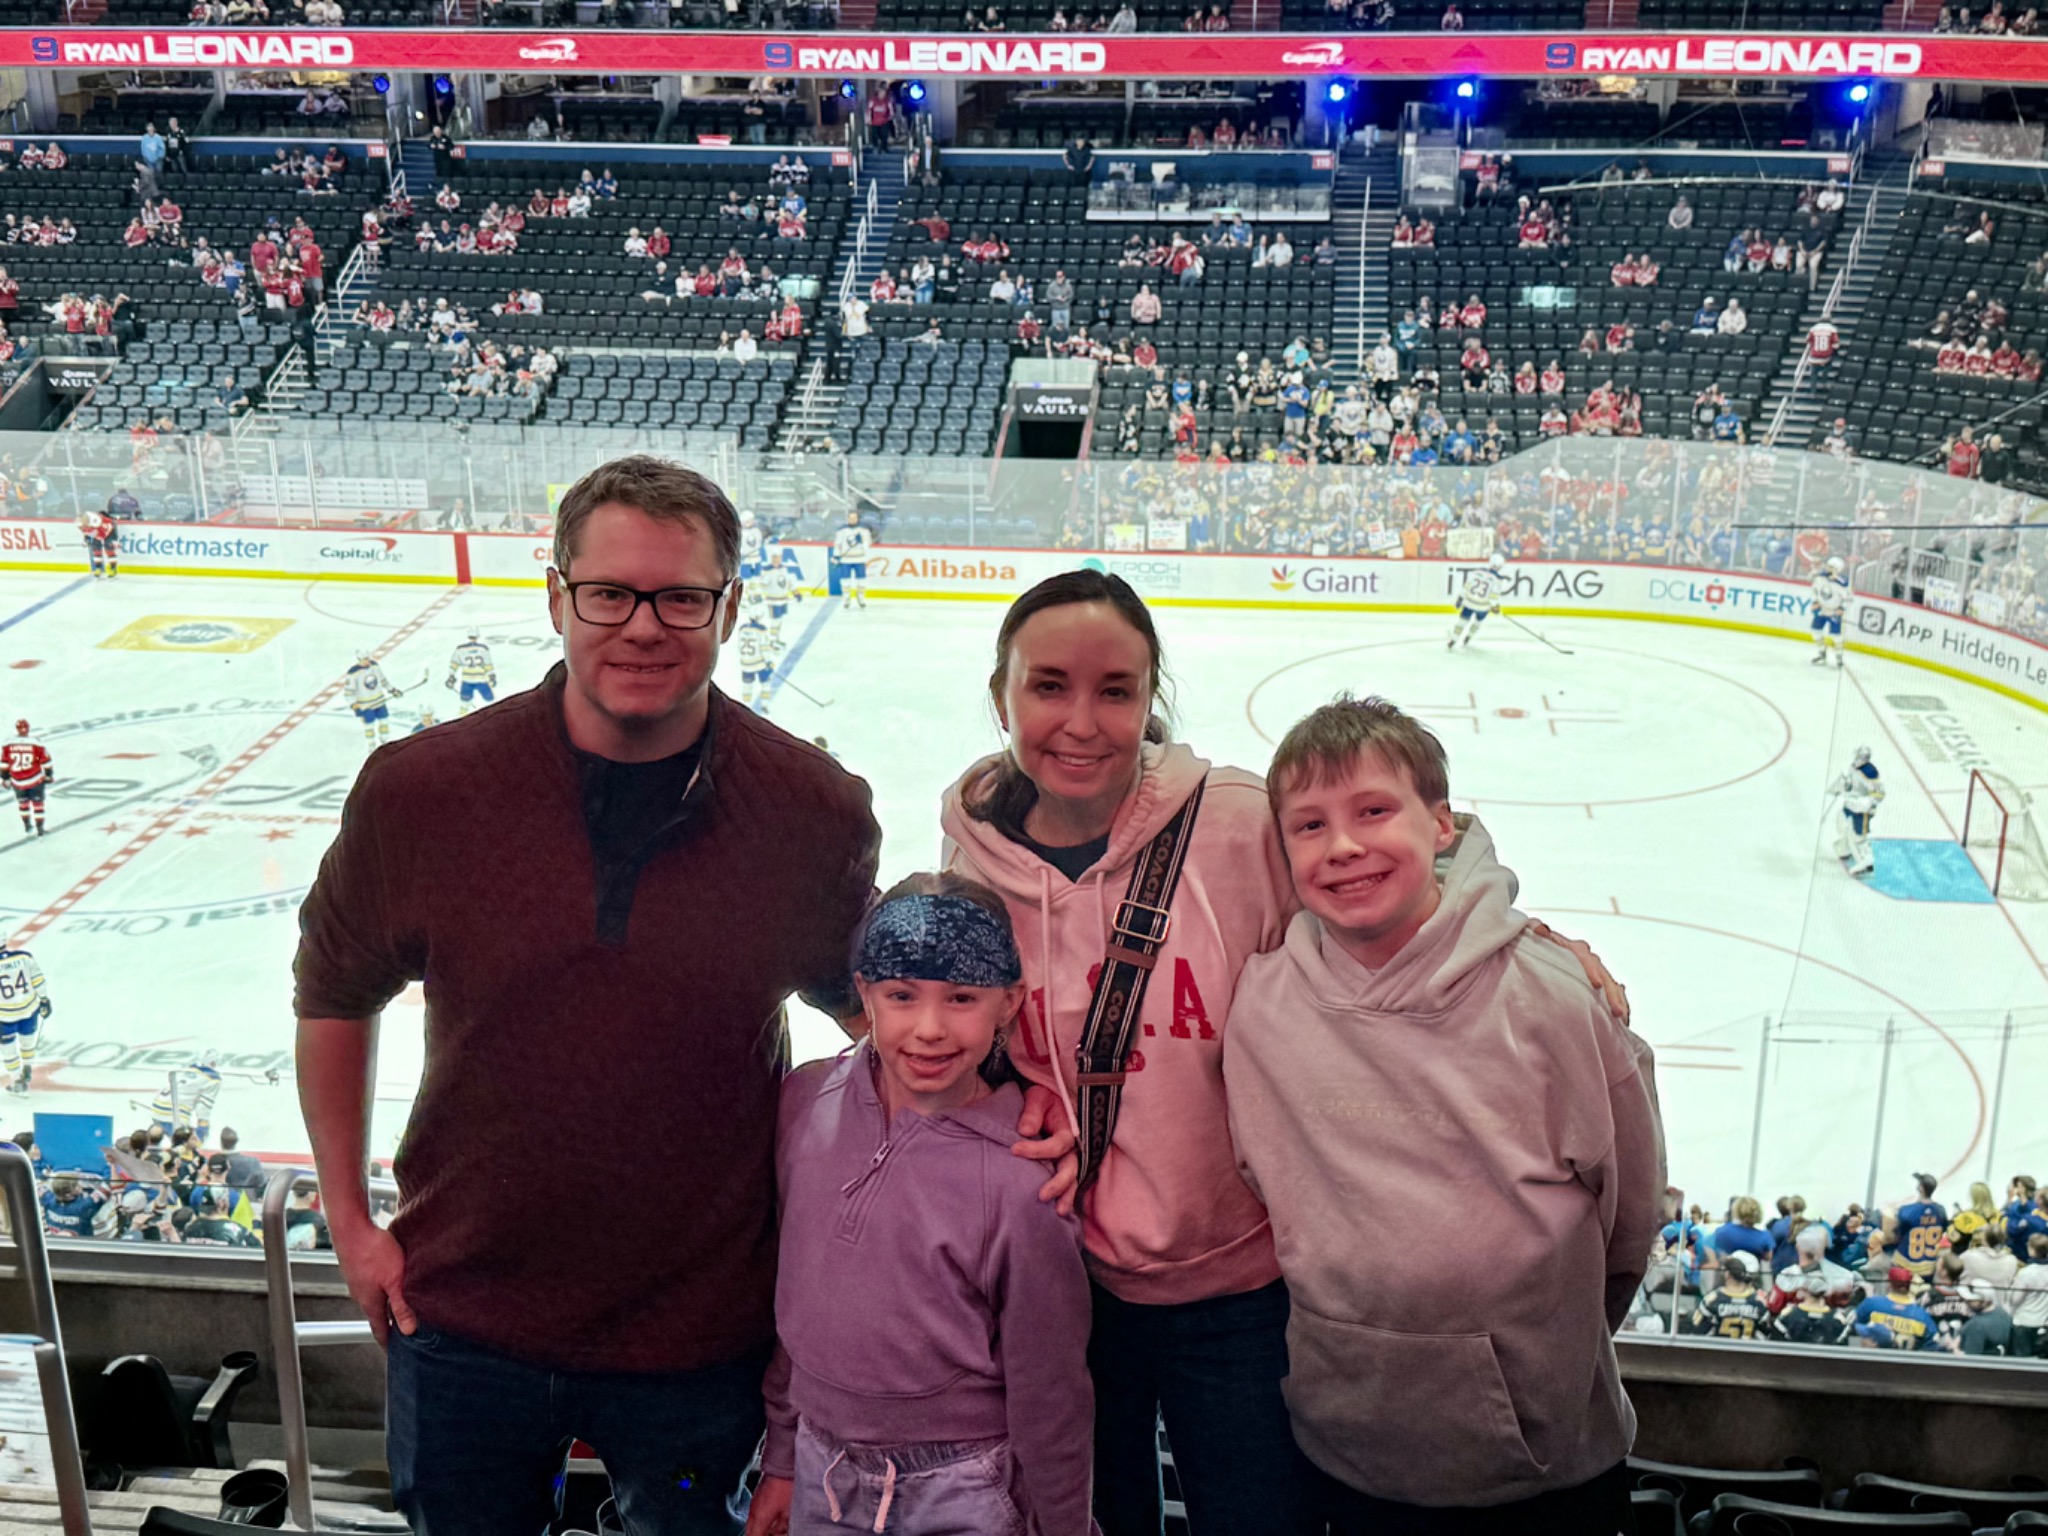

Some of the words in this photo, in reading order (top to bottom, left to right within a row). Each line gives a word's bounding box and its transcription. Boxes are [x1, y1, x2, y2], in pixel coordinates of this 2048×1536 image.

[32, 37, 59, 61] 9
[65, 43, 140, 62] RYAN
[144, 36, 353, 64] LEONARD
[764, 43, 793, 68] 9
[799, 48, 879, 69] RYAN
[884, 41, 1105, 72] LEONARD
[1545, 43, 1575, 69] 9
[1582, 47, 1670, 70] RYAN
[1675, 40, 1922, 73] LEONARD
[120, 533, 269, 559] ticketmaster
[896, 558, 1017, 580] Alibaba
[1302, 567, 1379, 594] Giant
[1542, 570, 1604, 599] AG
[1942, 629, 2020, 674] Hidden
[1141, 831, 1174, 906] COACH
[0, 969, 29, 1000] 64
[1908, 1226, 1943, 1260] 89
